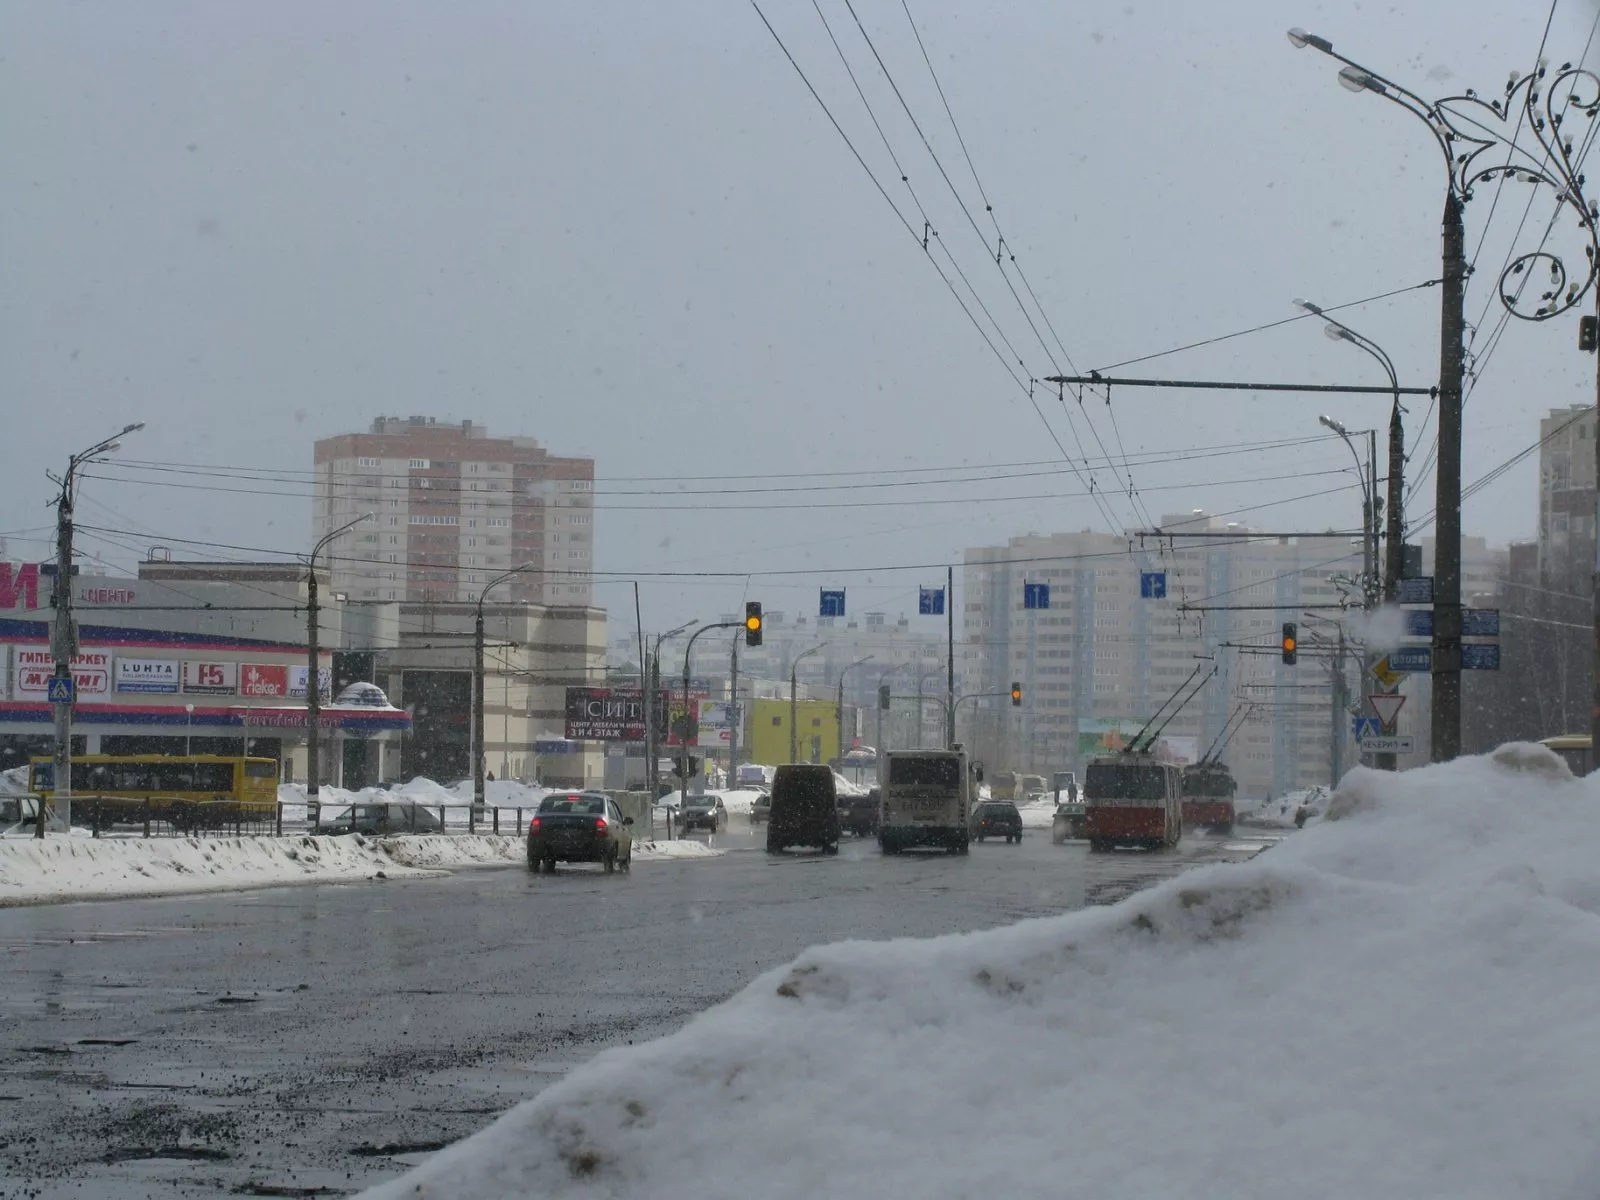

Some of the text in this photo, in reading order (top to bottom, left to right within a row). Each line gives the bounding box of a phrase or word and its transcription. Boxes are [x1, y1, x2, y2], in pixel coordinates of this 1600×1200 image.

[19, 652, 108, 664] ГИПЕАРКЕТ
[123, 664, 173, 673] LUHTA
[246, 680, 281, 694] rieker
[595, 729, 620, 737] ЭТАЖ
